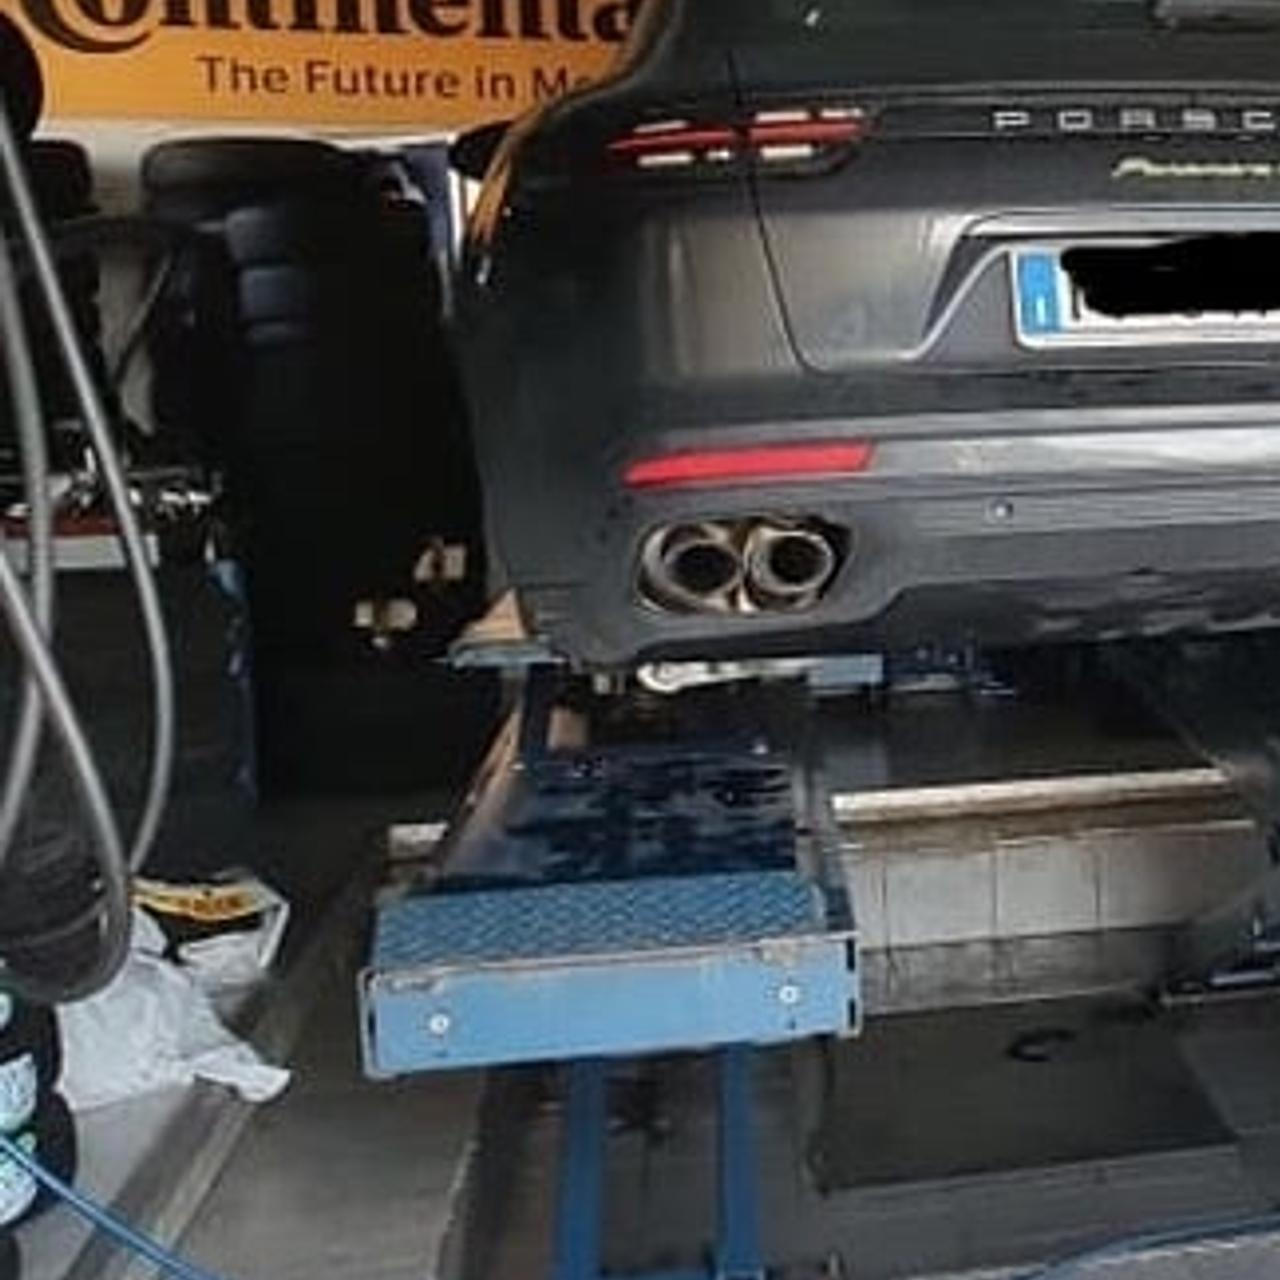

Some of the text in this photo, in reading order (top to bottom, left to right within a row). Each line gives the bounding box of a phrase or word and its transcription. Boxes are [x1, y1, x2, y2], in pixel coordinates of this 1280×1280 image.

[198, 56, 289, 95] The
[305, 60, 460, 100] Future
[474, 65, 516, 100] in
